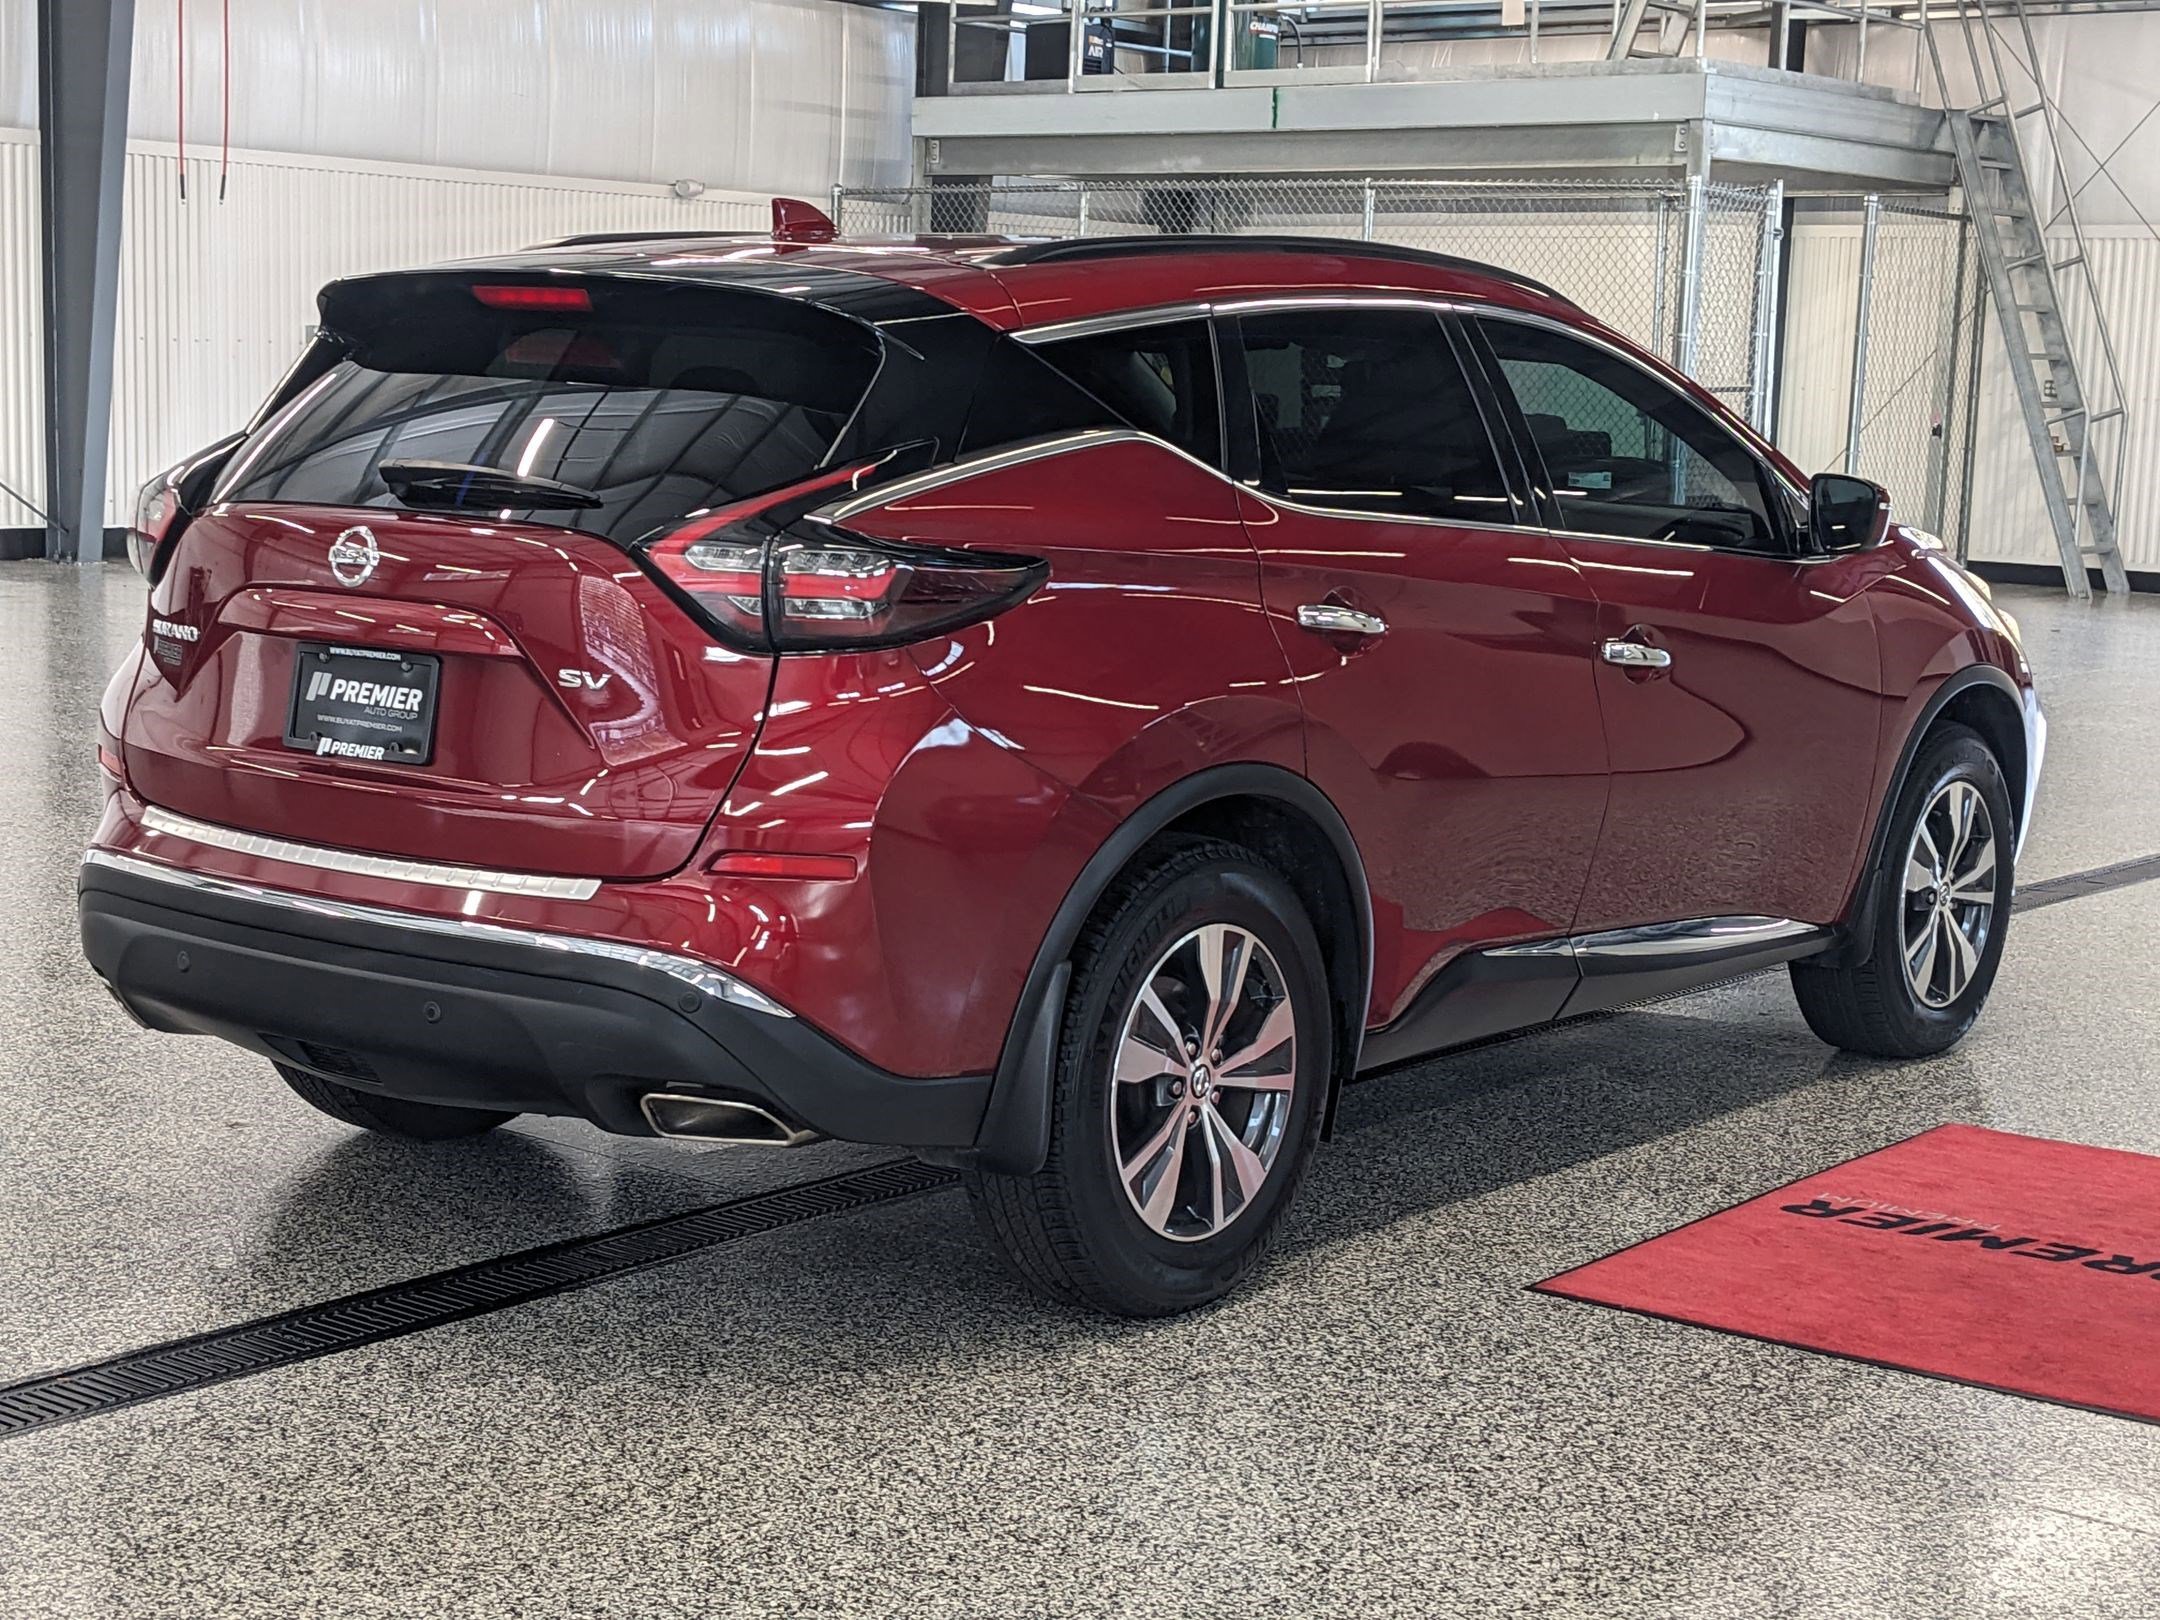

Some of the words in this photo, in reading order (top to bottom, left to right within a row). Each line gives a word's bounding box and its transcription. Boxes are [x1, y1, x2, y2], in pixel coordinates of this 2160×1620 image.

[1088, 45, 1104, 59] AIR
[558, 668, 612, 690] SV
[330, 678, 423, 711] PREMIER
[364, 706, 386, 717] AUTO
[388, 709, 418, 720] GROUP
[330, 740, 385, 760] PREMIER
[1780, 1199, 2160, 1281] REMIER
